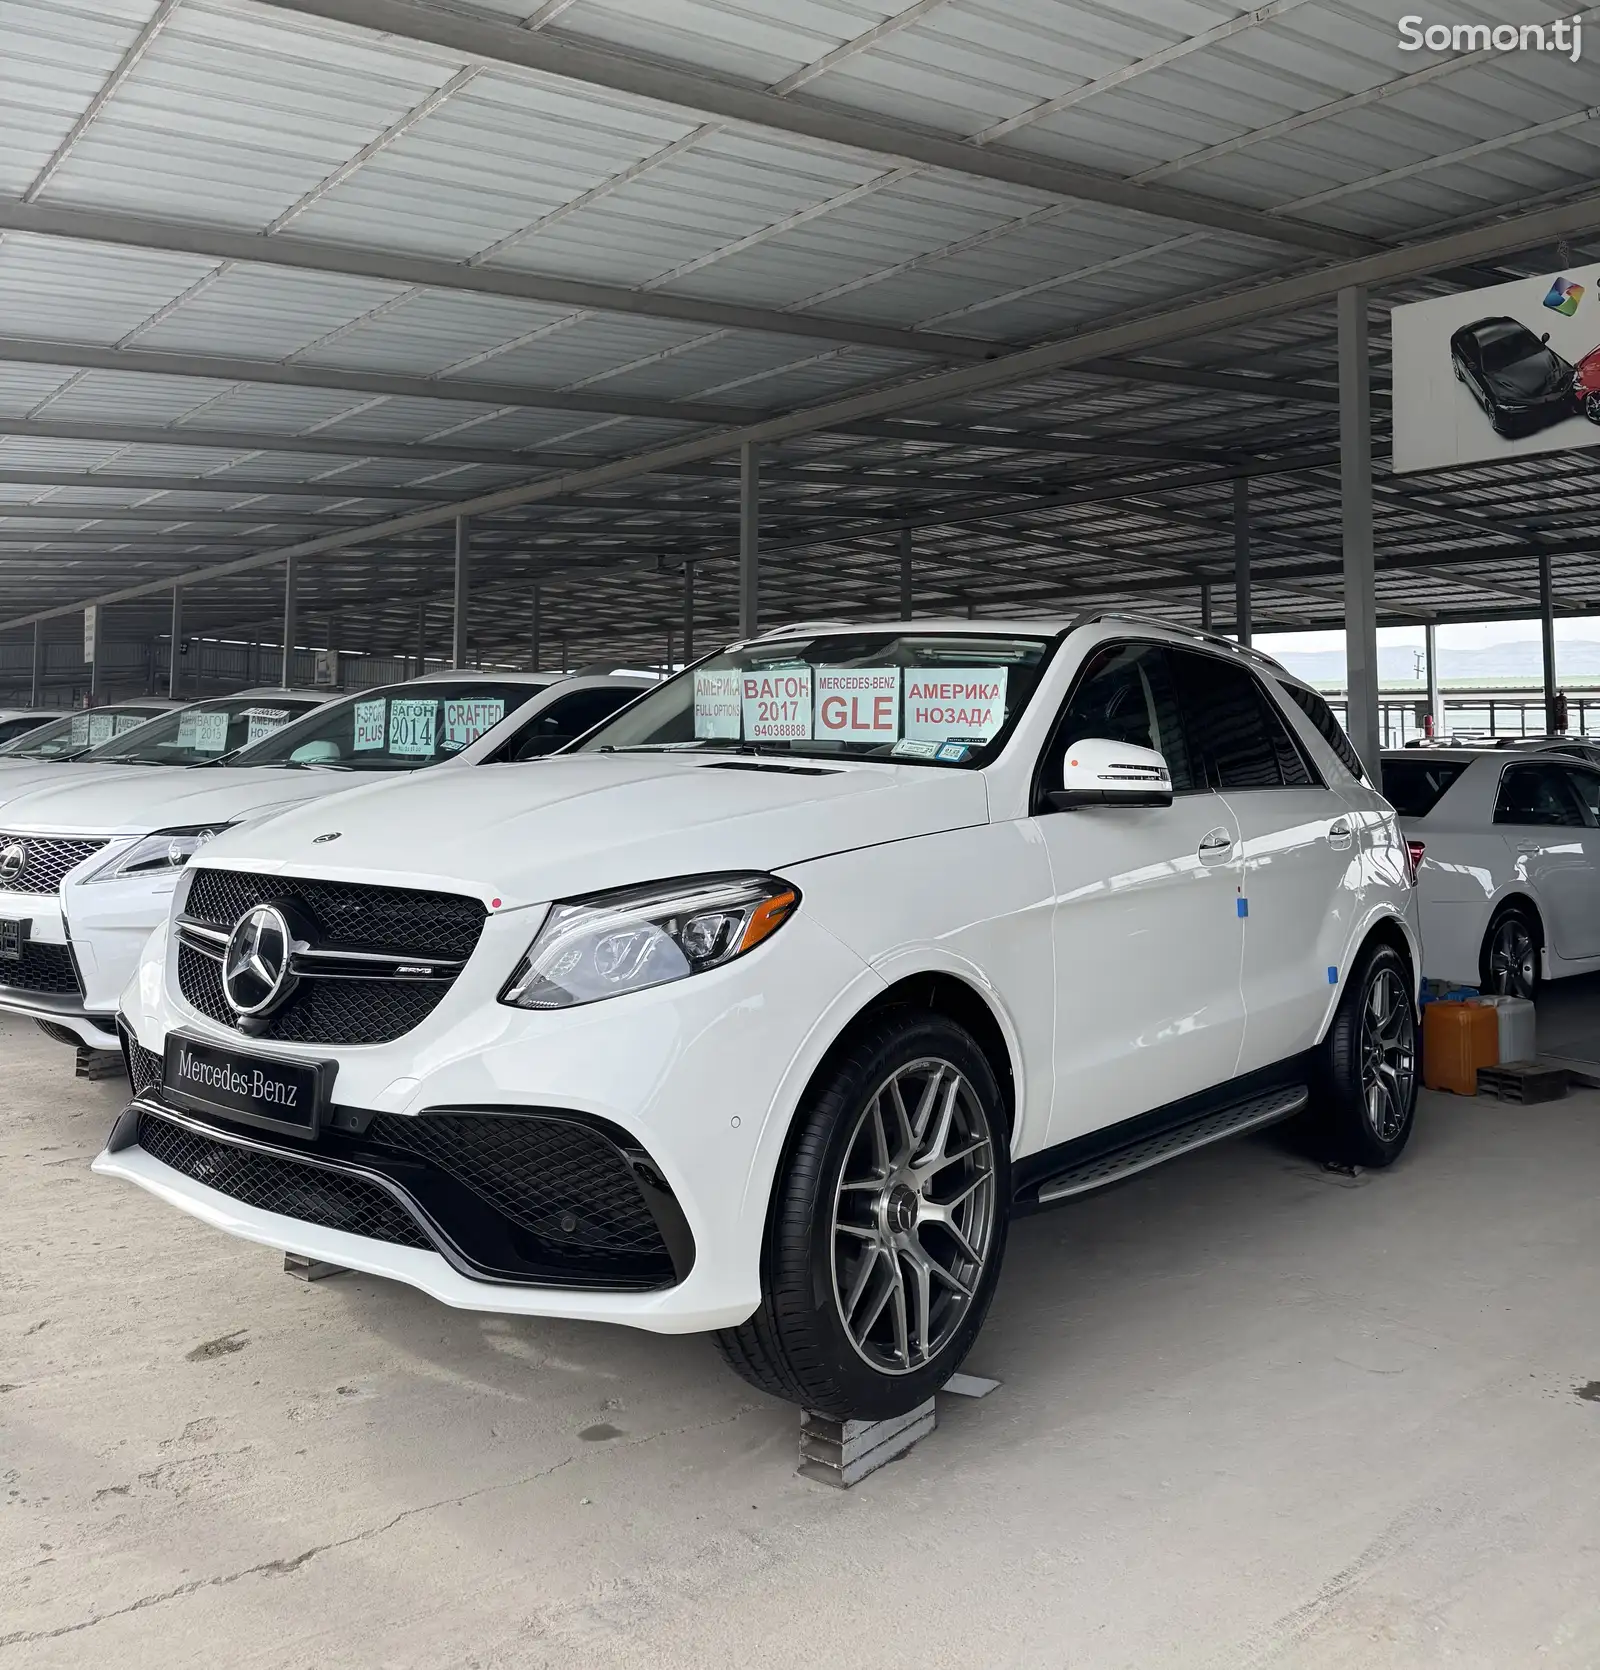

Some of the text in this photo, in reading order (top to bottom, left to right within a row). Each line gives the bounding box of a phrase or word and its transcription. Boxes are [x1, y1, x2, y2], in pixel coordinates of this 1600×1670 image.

[744, 677, 809, 699] ВАГОН
[819, 677, 896, 690] MERCEDES-BENZ
[908, 683, 1000, 700] АМЕРИКА
[392, 706, 434, 717] ВАГОН
[447, 704, 501, 726] CRAFTED
[696, 704, 713, 717] FULL
[757, 701, 799, 722] 2017
[821, 696, 893, 730] GLE
[916, 708, 993, 727] НОЗАДА
[358, 724, 383, 743] PLUS
[391, 717, 432, 746] 2014
[754, 724, 806, 737] 940388888
[178, 1049, 298, 1107] Mercedes-Benz
